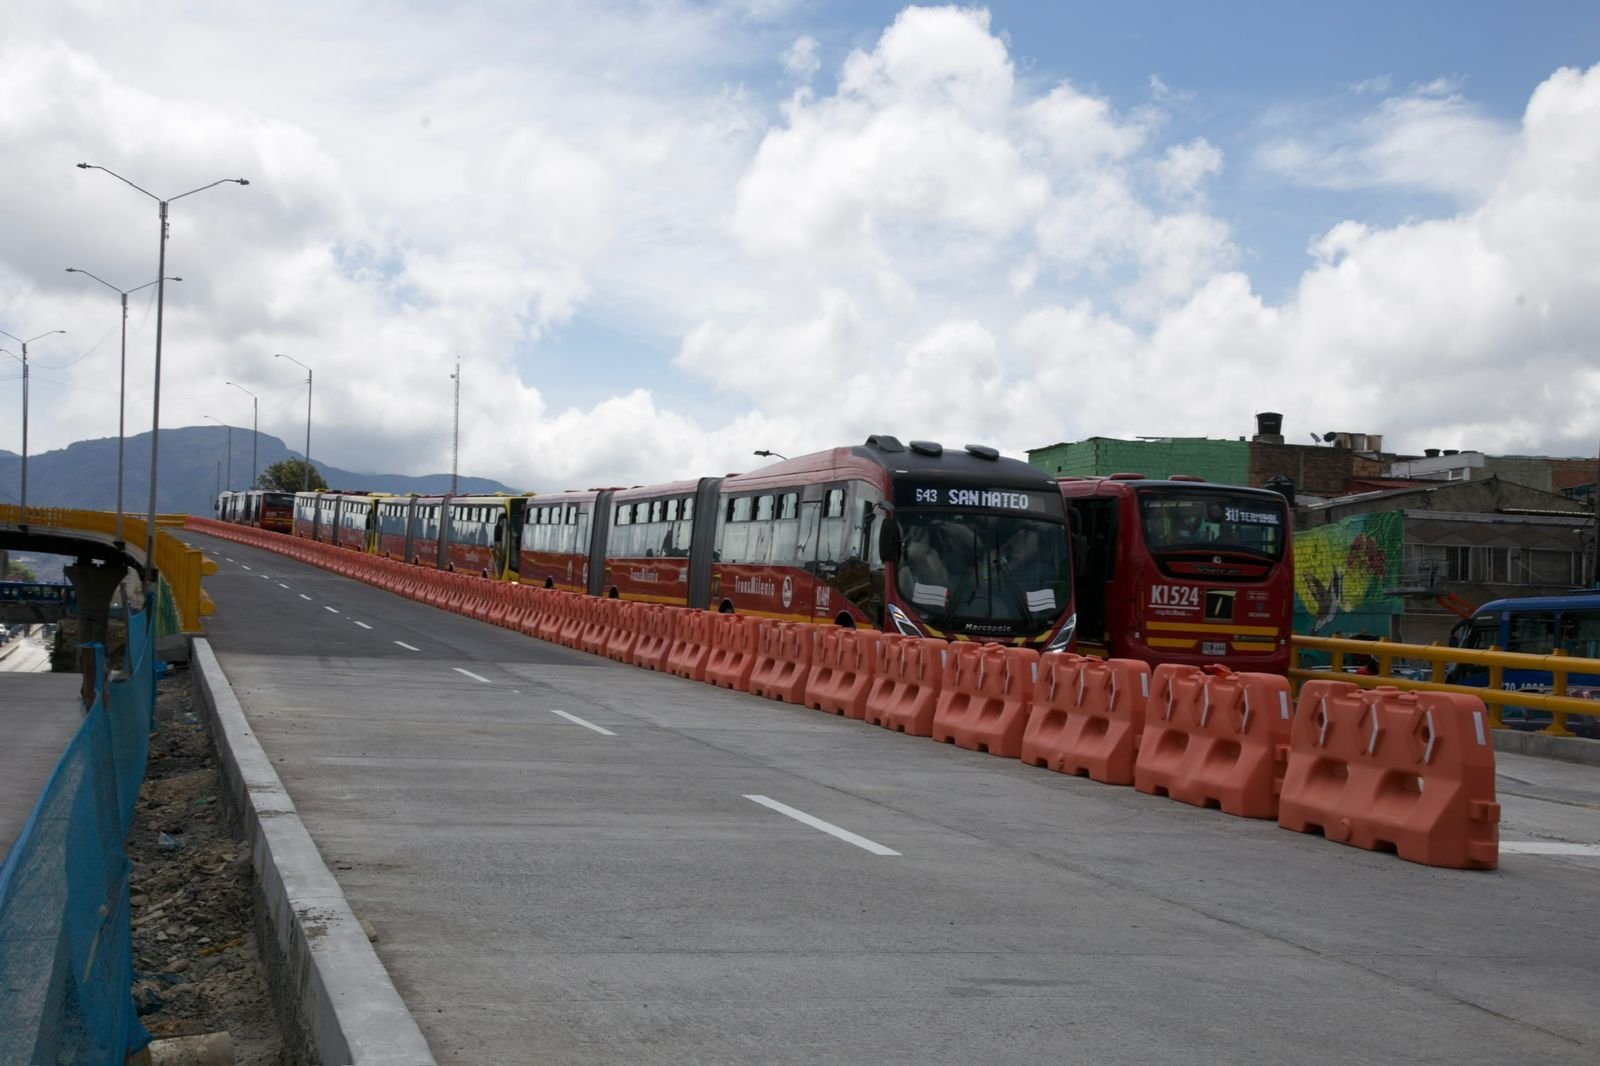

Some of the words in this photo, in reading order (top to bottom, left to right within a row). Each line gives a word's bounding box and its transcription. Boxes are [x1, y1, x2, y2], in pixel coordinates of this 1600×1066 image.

[948, 489, 979, 506] SAN
[981, 491, 1029, 509] MATEO
[735, 575, 775, 597] TransMilenio
[1151, 585, 1199, 606] K1524
